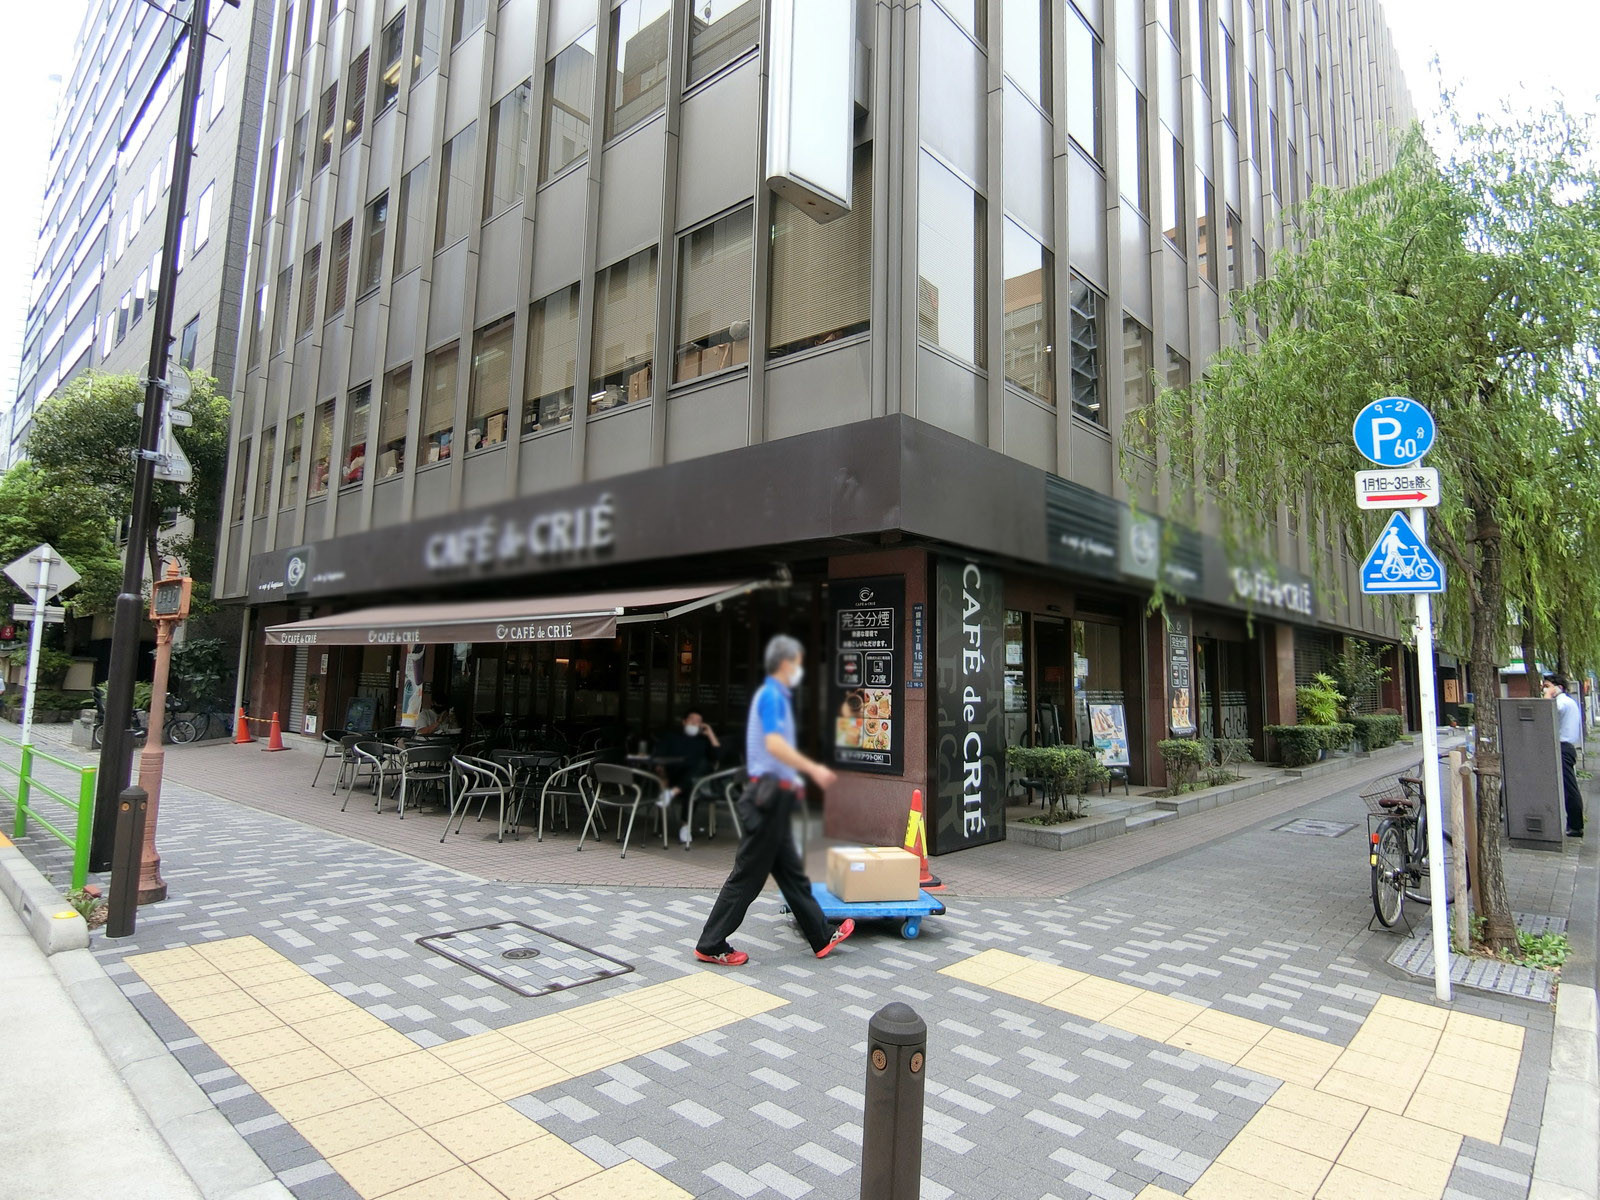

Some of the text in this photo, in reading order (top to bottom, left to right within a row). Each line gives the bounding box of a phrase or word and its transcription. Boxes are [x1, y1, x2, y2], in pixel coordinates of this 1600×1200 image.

[1374, 401, 1410, 414] 9-21
[1371, 417, 1402, 460] P
[842, 611, 890, 627] 完全分煙
[402, 629, 420, 642] CRIÉ
[510, 622, 573, 639] CAFÉ de CRIÉ
[914, 652, 923, 660] 16
[963, 563, 986, 838] CAFÉ de CRIÉ
